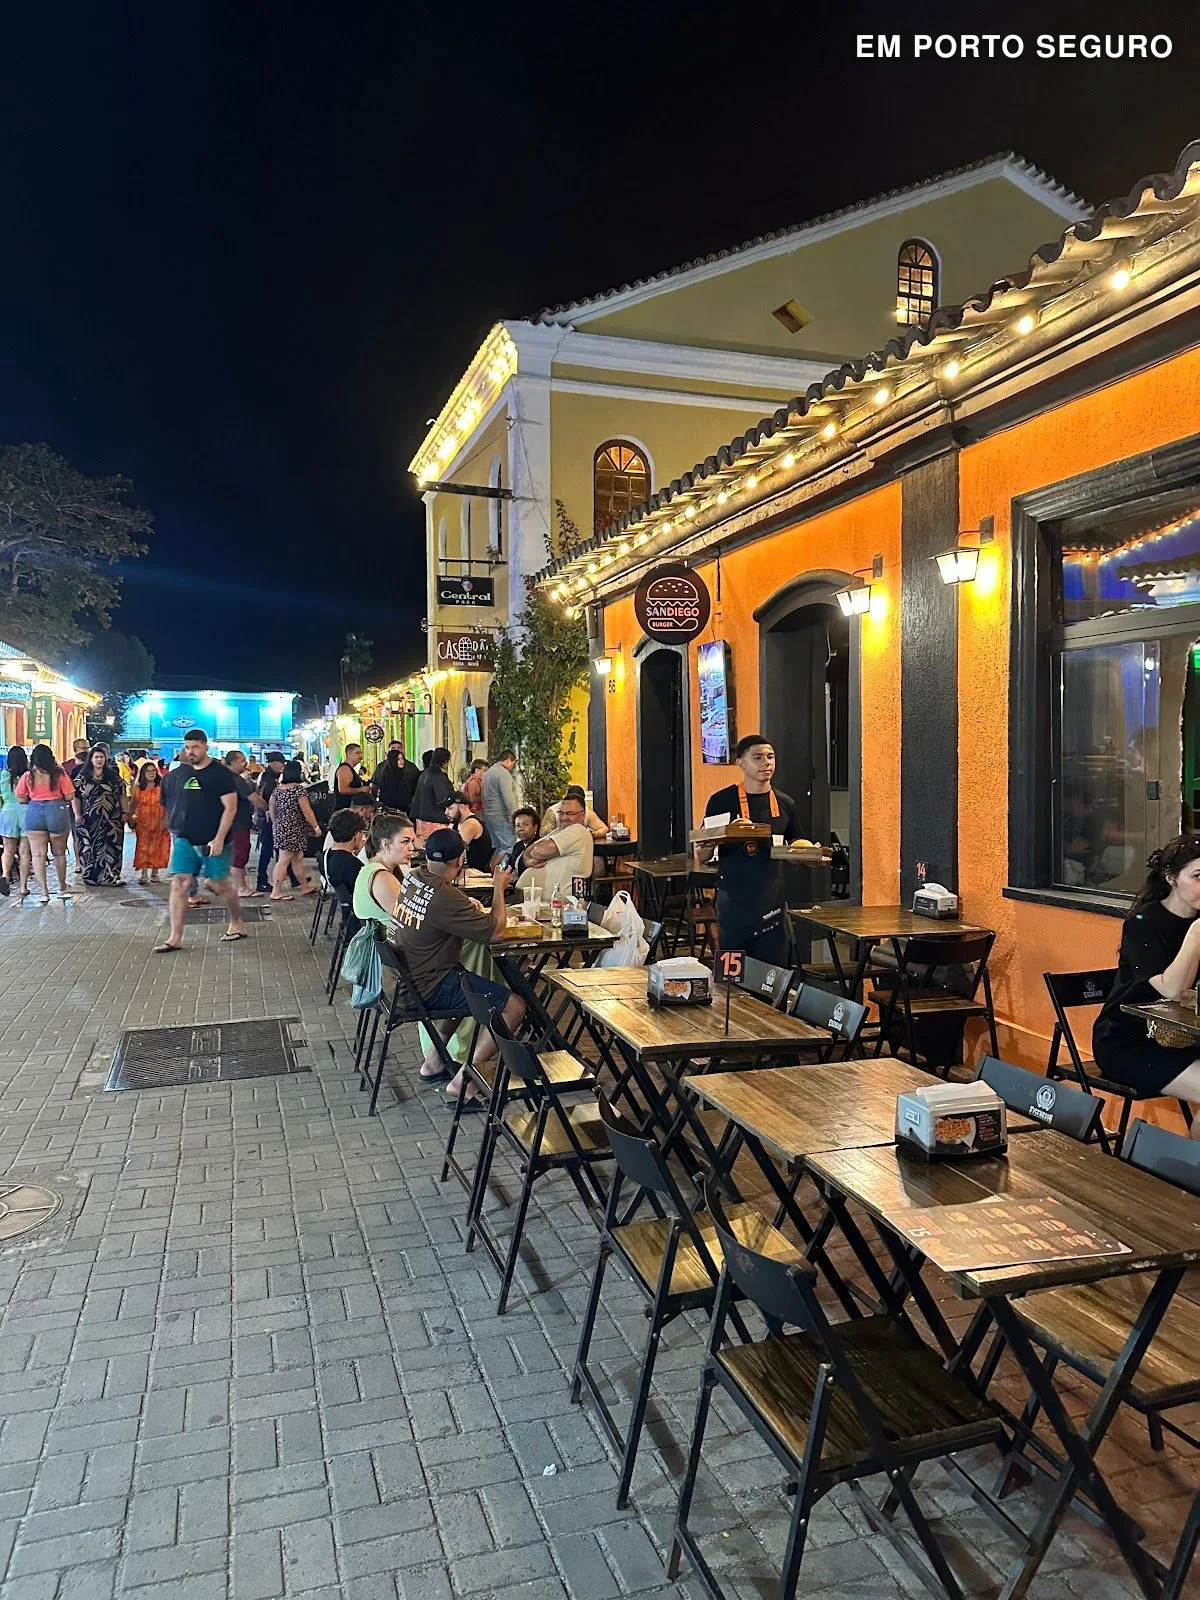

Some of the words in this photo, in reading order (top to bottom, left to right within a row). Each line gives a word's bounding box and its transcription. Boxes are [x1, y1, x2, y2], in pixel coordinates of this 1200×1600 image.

[440, 590, 491, 601] Central
[646, 607, 700, 617] SANDIEGO
[608, 679, 616, 694] 56
[916, 862, 926, 877] 14
[573, 878, 584, 893] 13
[720, 952, 742, 977] 15
